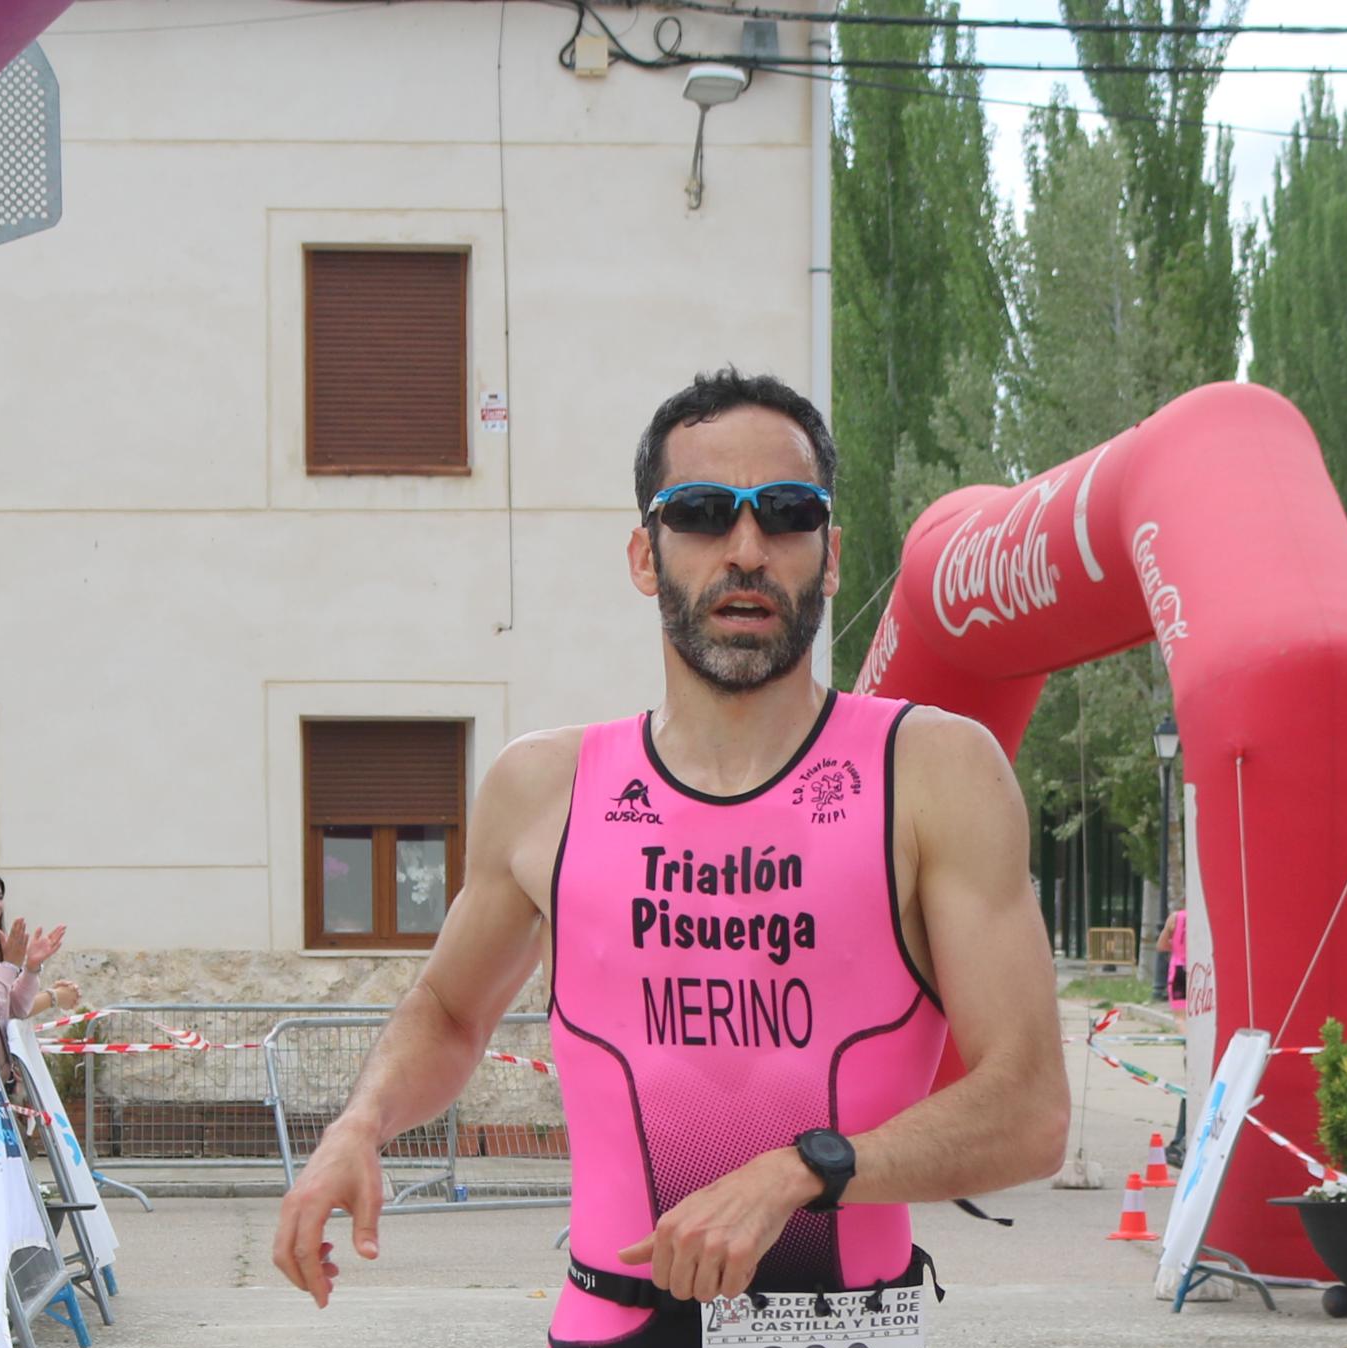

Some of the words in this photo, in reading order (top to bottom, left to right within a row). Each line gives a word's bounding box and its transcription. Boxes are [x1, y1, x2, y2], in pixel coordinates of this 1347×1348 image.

[604, 811, 664, 825] austral
[811, 808, 846, 824] TRIPI
[641, 845, 802, 895] Triatlón
[632, 897, 816, 965] Pisuerga
[642, 977, 813, 1049] MERINO
[568, 1265, 596, 1290] enji
[897, 1290, 921, 1300] DE
[751, 1308, 842, 1320] TRIATLN
[847, 1307, 856, 1317] Y
[896, 1302, 920, 1313] DE
[751, 1320, 846, 1332] CASTILLA
[853, 1319, 863, 1328] Y
[870, 1315, 919, 1327] LEON
